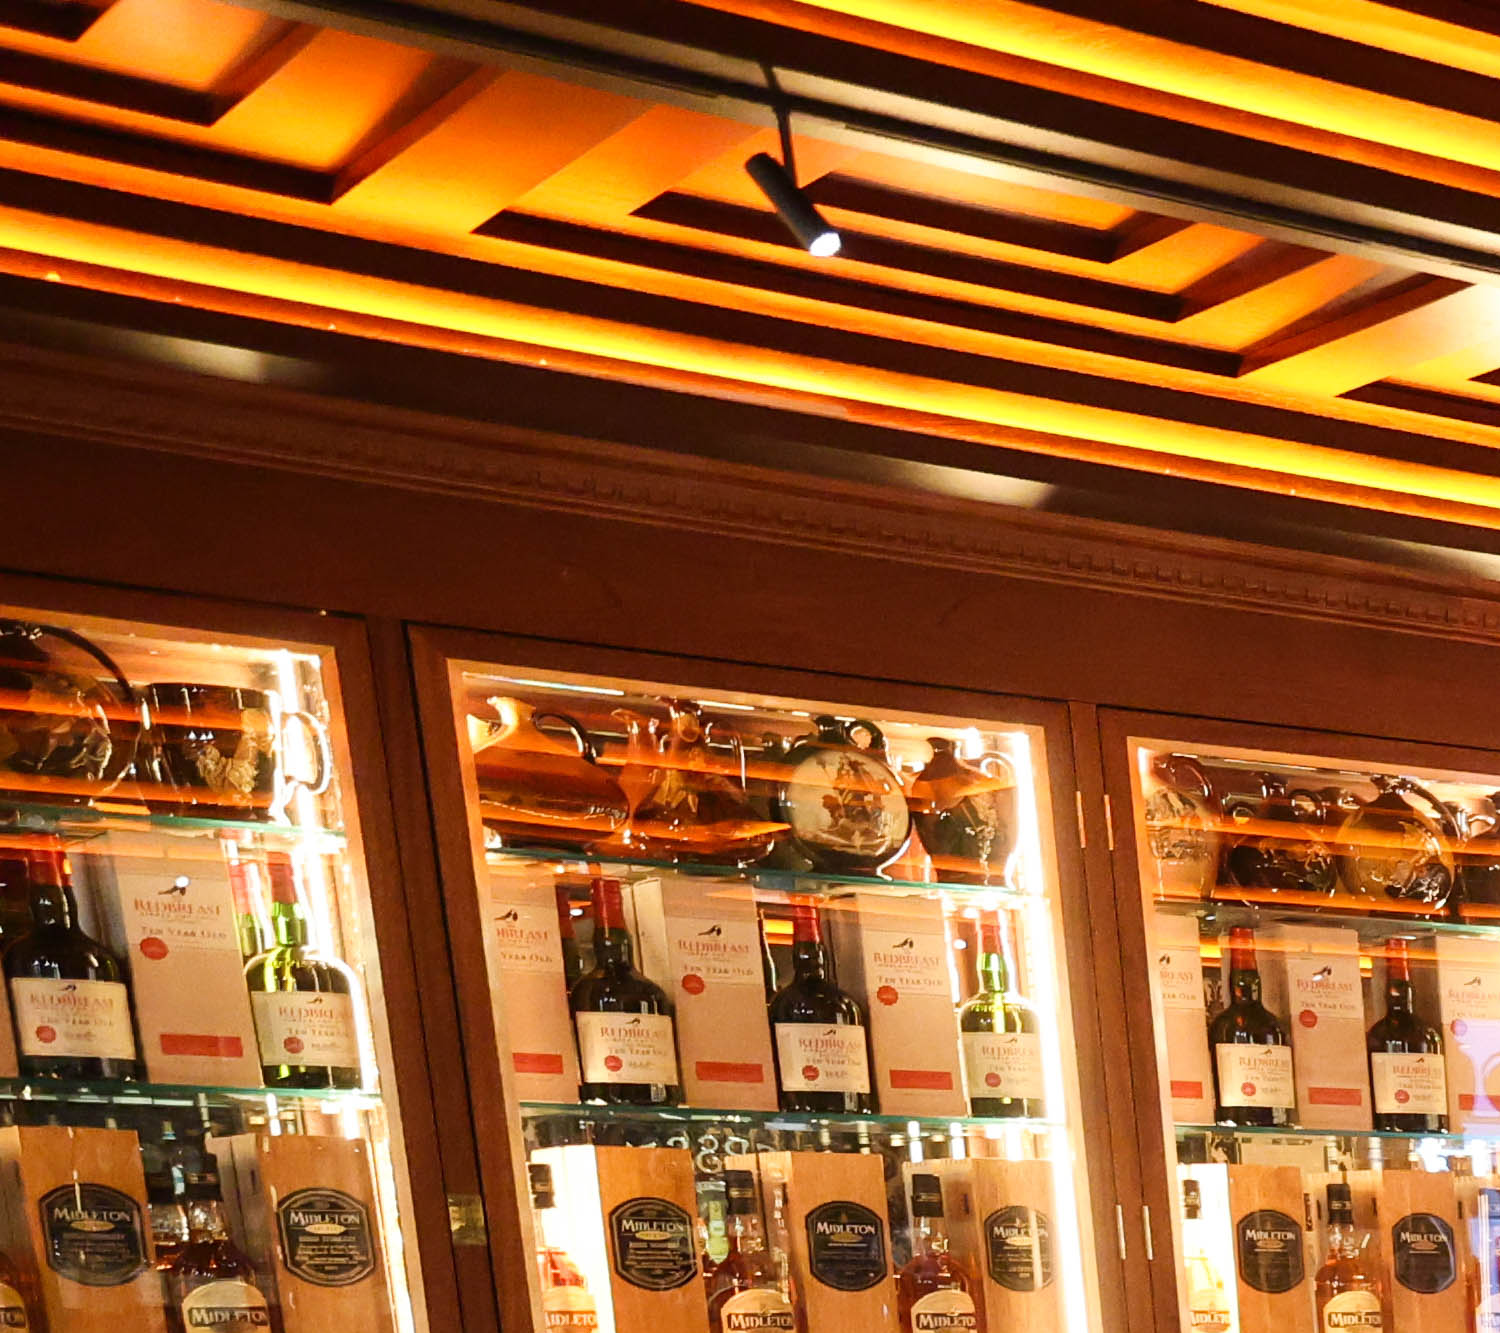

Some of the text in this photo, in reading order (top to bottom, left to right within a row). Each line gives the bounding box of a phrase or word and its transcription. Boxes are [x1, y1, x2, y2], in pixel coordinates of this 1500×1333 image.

[54, 1206, 132, 1223] MIDLETON
[289, 1209, 361, 1227] MIDLETON
[620, 1219, 684, 1235] MIDLETON
[816, 1221, 876, 1236] MIDLETON
[1245, 1228, 1296, 1242] MIDLETON
[1400, 1231, 1448, 1244] MIDLETON
[730, 1313, 793, 1329] MIDLETO
[919, 1314, 976, 1328] MIDLETO
